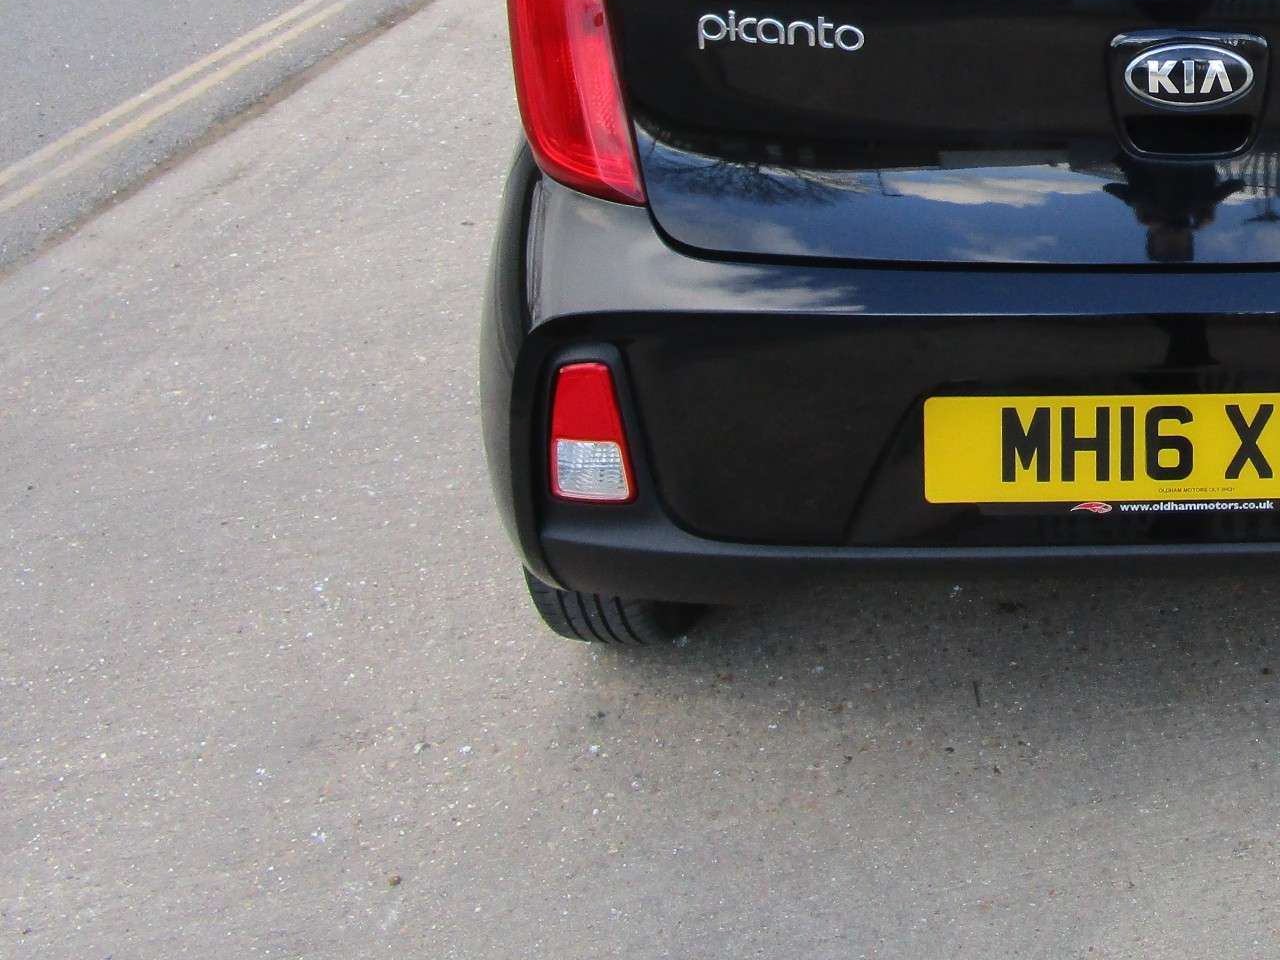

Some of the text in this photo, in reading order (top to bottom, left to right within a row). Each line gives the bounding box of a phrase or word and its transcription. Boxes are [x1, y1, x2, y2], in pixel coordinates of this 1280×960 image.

[697, 9, 865, 52] picanto
[1146, 60, 1233, 94] KIA
[1002, 406, 1194, 483] MH16
[1119, 500, 1274, 512] www.oldhammotors.co.uk
